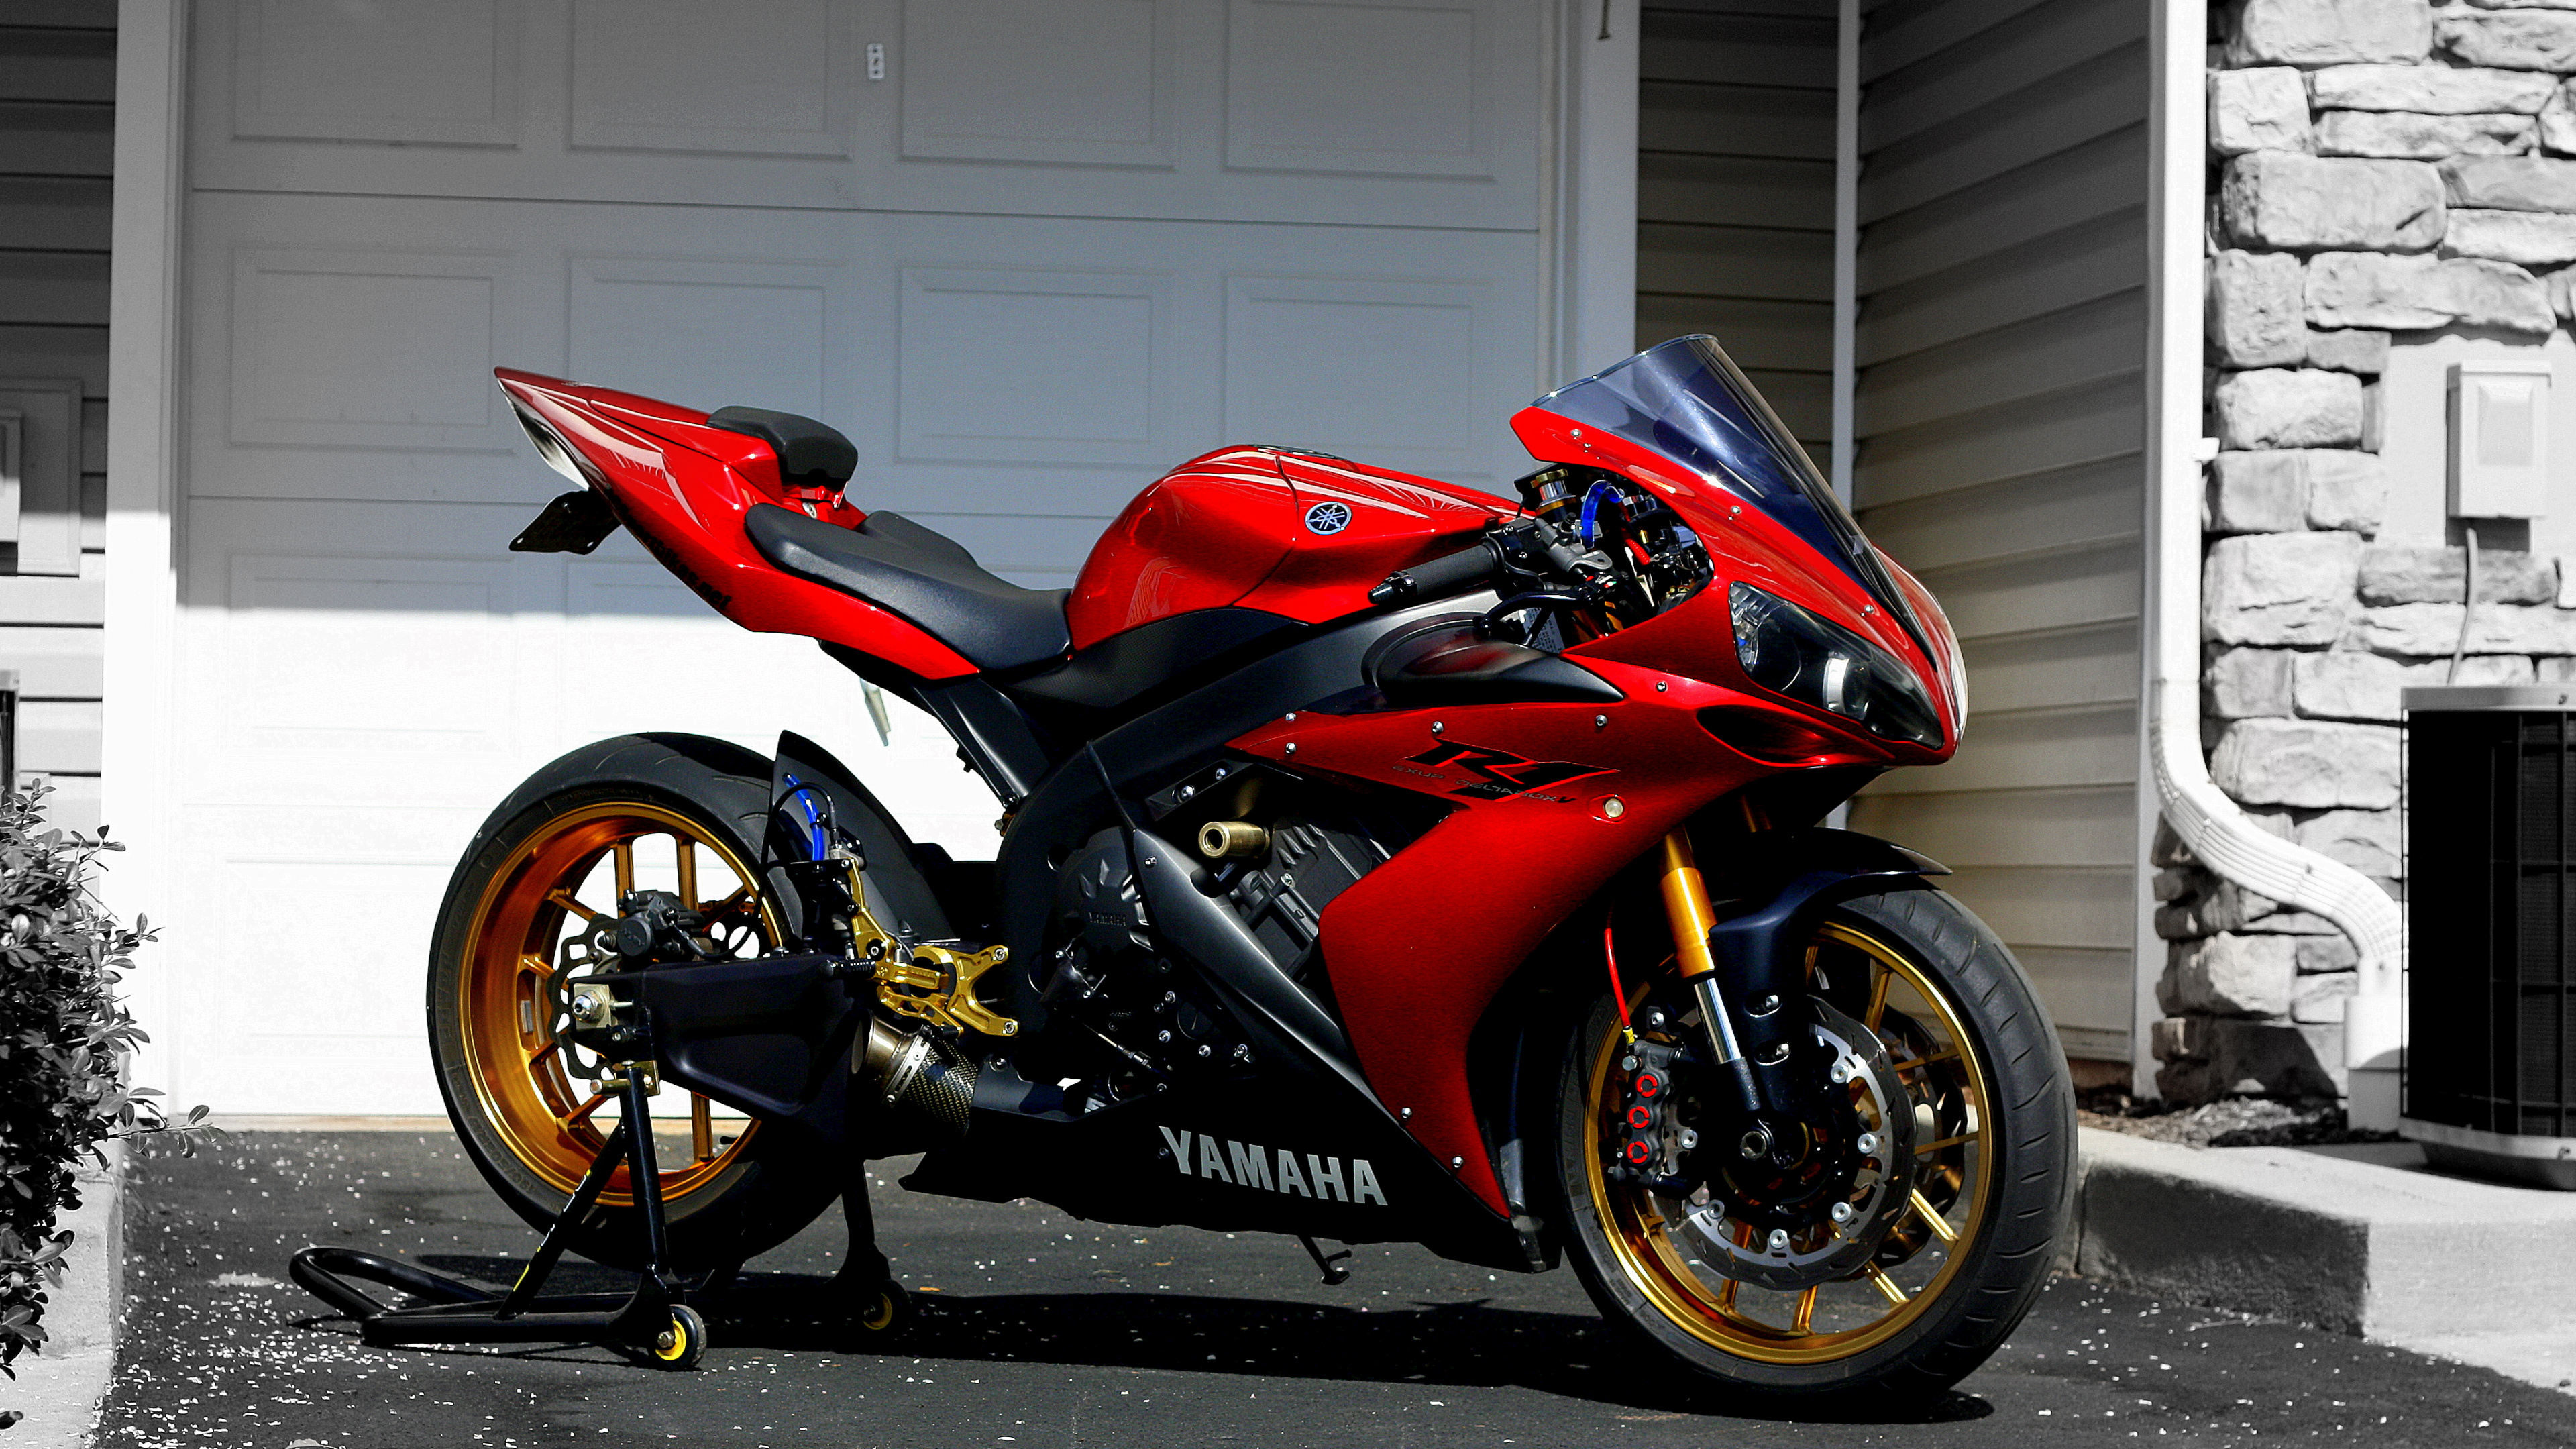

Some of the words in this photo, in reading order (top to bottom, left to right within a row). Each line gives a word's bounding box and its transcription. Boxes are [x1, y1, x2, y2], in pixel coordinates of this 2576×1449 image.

[1392, 765, 1444, 779] EXUP
[1456, 779, 1558, 802] DELTABOX
[1400, 737, 1621, 802] R1
[1159, 1126, 1389, 1206] YAMAHA
